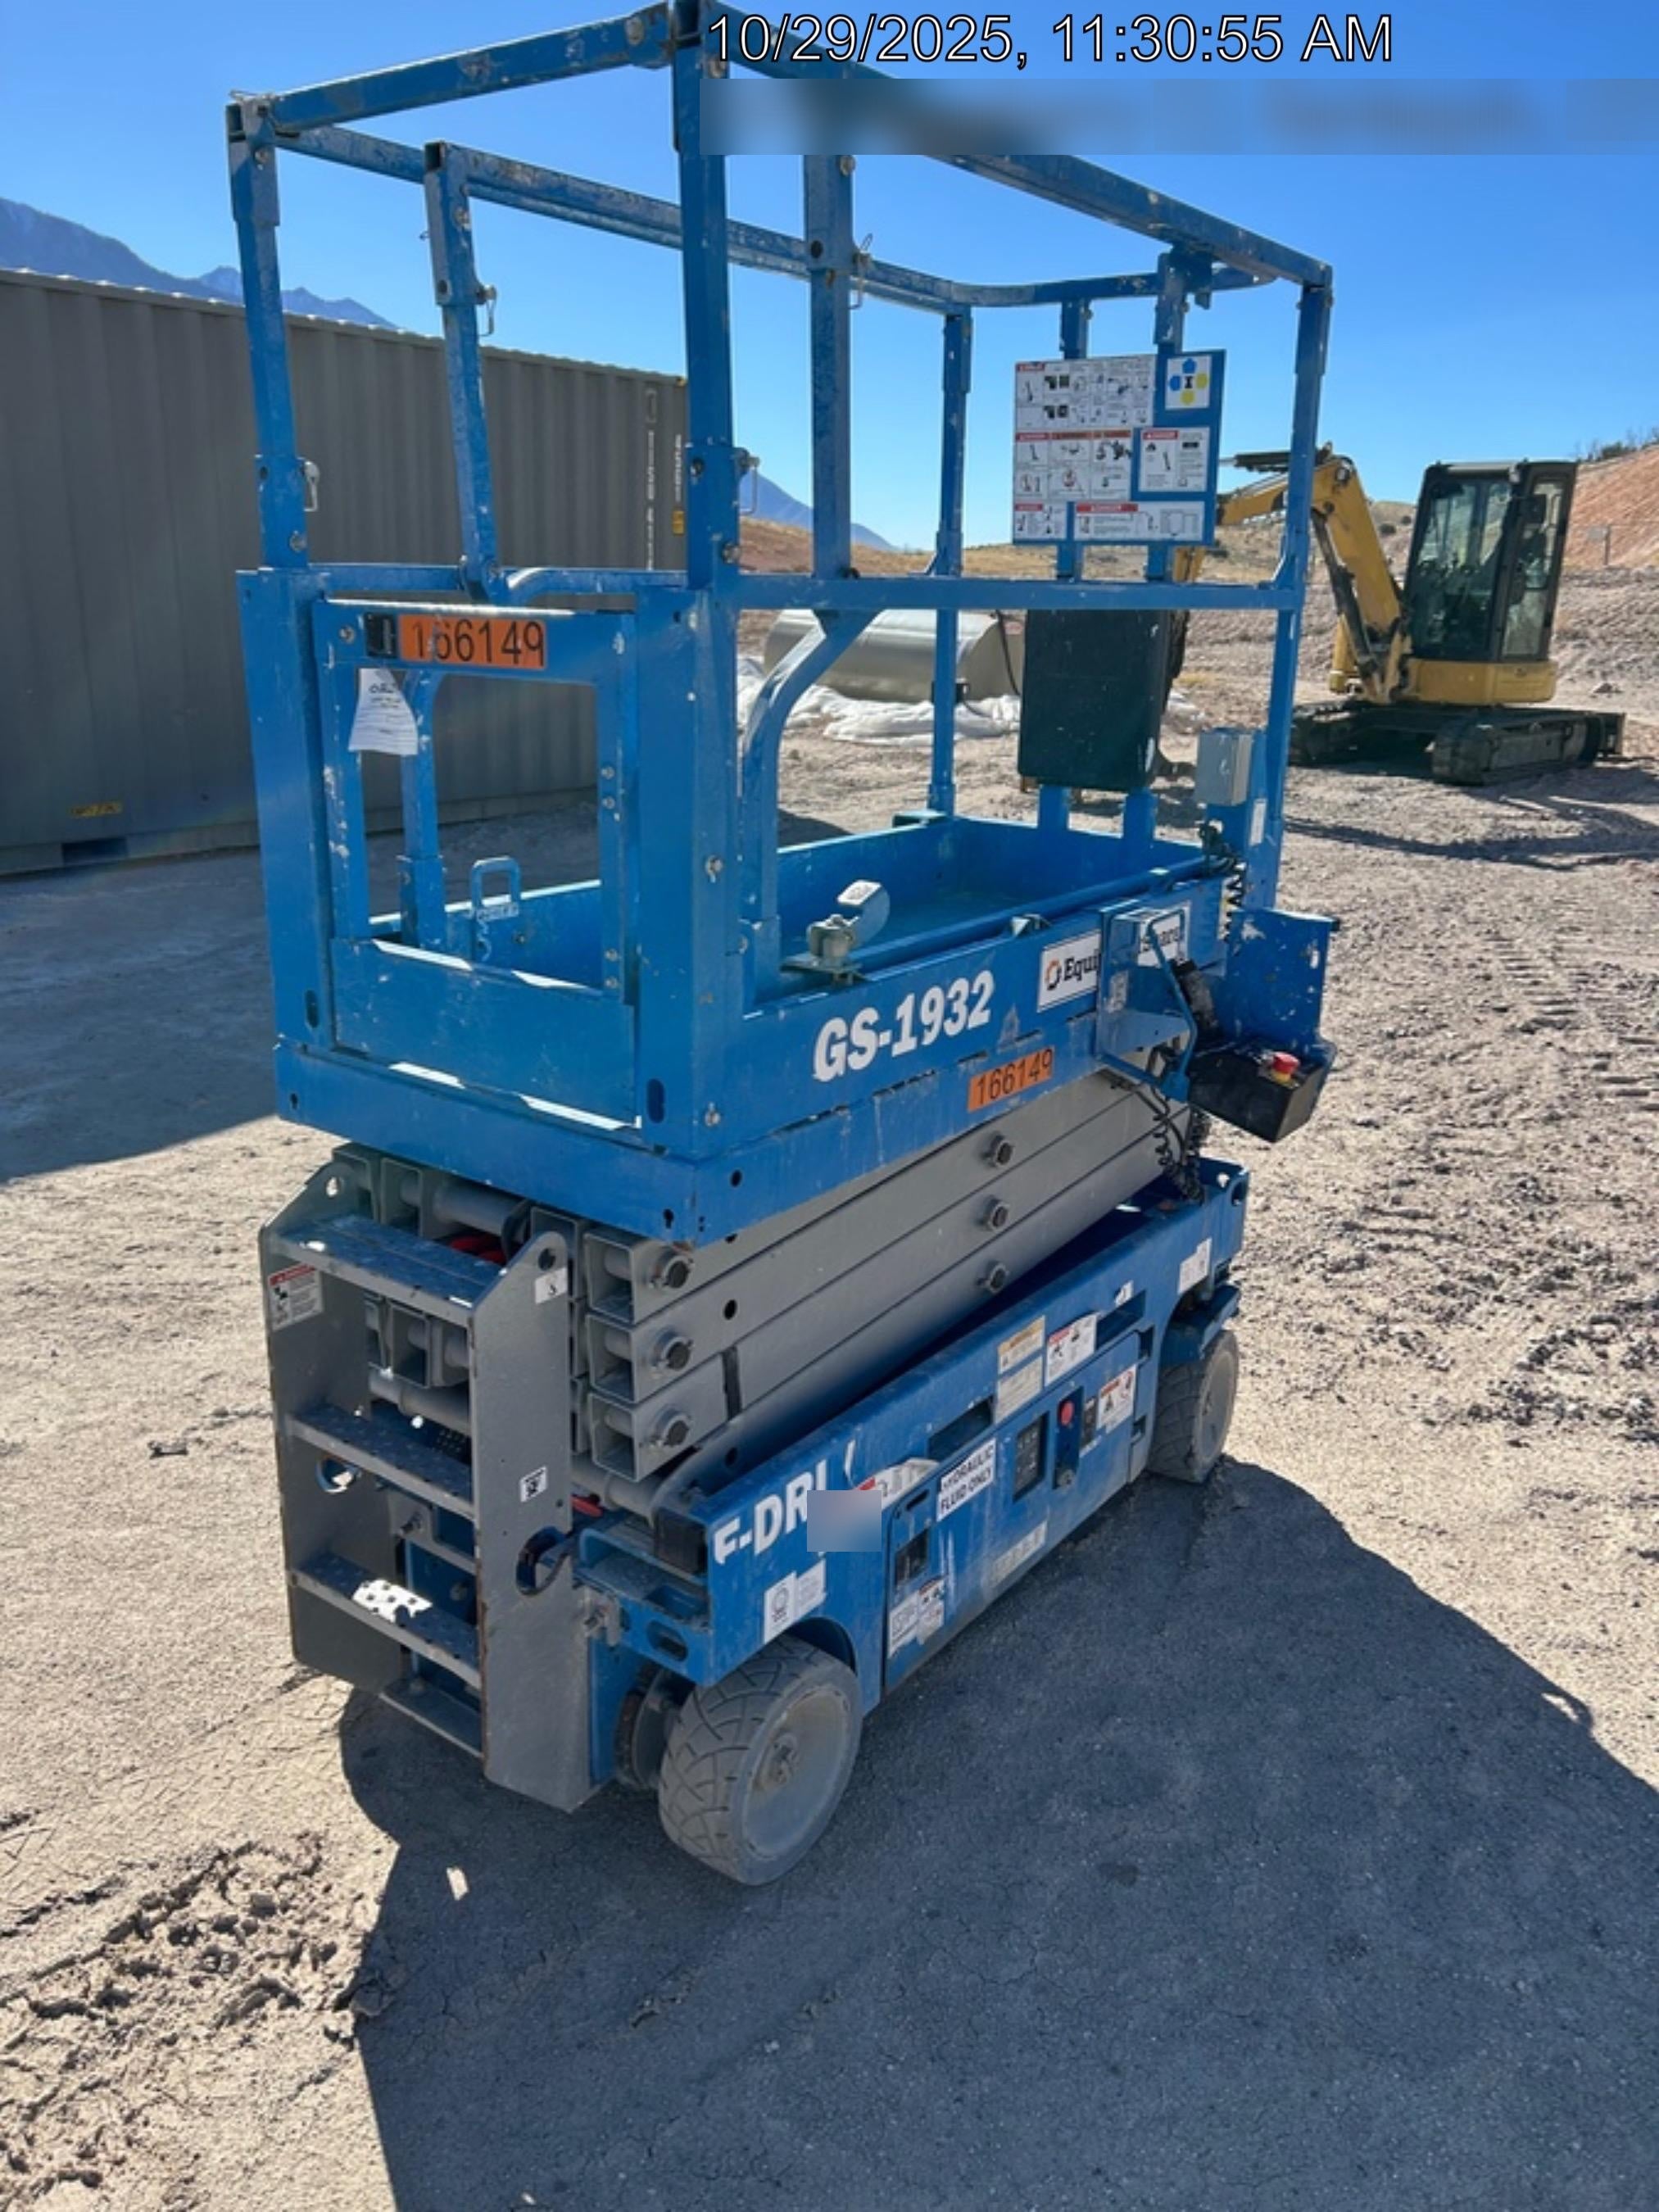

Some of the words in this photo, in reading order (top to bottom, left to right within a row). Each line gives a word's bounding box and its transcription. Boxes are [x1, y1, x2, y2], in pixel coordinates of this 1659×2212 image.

[413, 619, 545, 667] 166149
[813, 970, 995, 1082] GS-1932
[976, 1049, 1053, 1106] 166149
